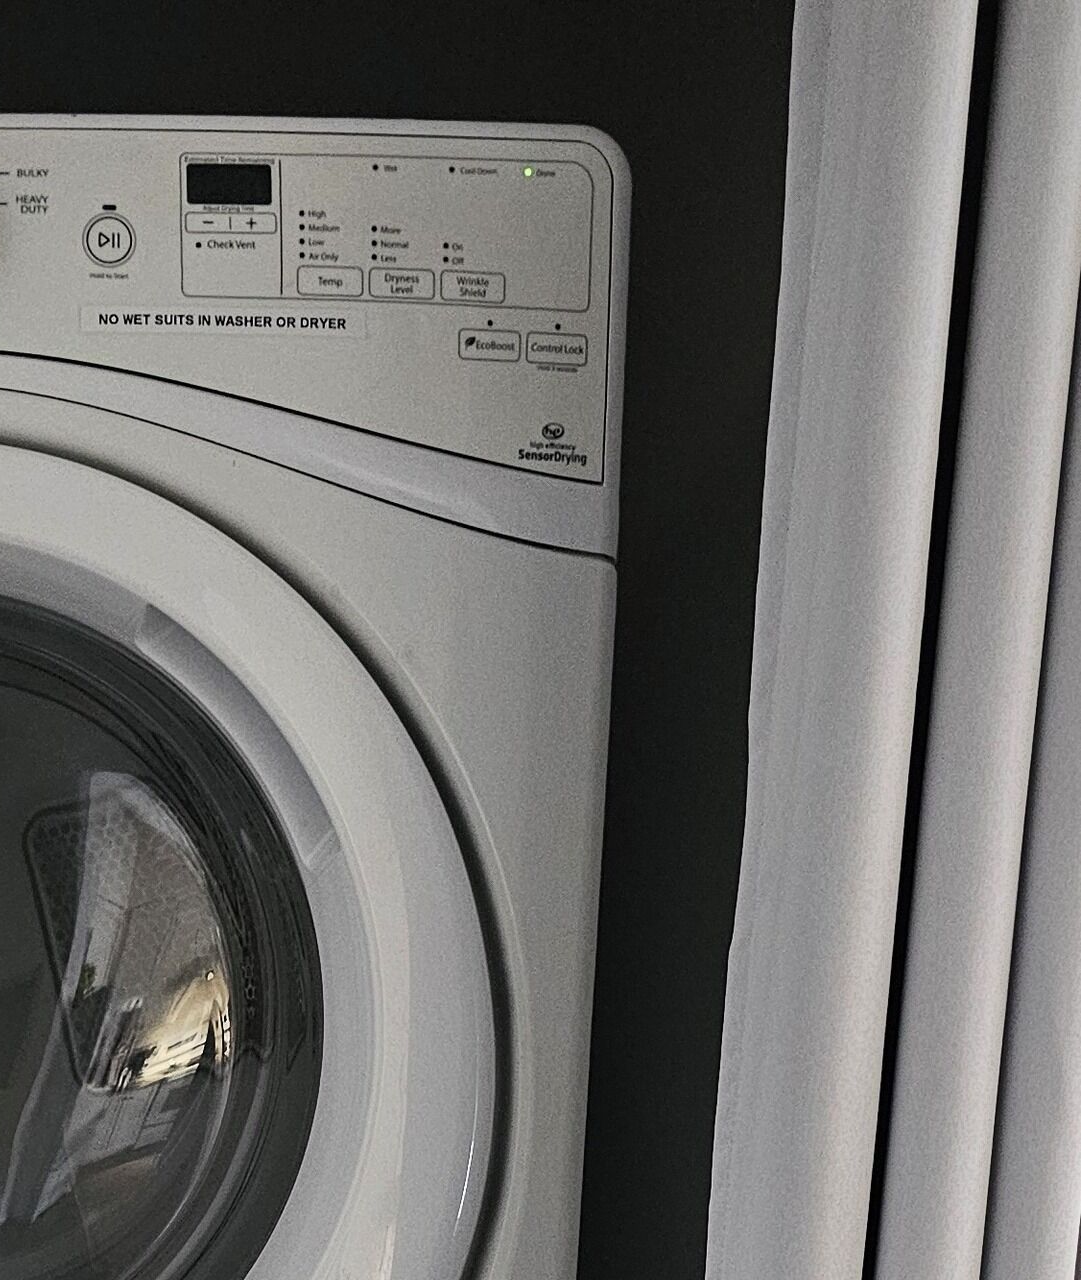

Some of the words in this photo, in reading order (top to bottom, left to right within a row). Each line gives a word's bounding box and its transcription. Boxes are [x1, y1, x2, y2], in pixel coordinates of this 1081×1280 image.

[16, 169, 50, 178] BULKY
[16, 196, 49, 205] HEAVY
[21, 205, 48, 214] DUTY
[308, 210, 327, 219] High
[308, 224, 341, 232] Medium
[380, 226, 401, 235] More
[207, 239, 234, 249] Check
[235, 240, 256, 249] Vent
[308, 238, 325, 246] Low
[380, 240, 409, 249] Normal
[308, 253, 320, 261] Air
[320, 253, 339, 262] Only
[380, 255, 397, 263] Less
[318, 276, 343, 288] Temp
[384, 274, 419, 285] Dryness
[456, 276, 490, 287] Wrinkle
[390, 285, 413, 294] Level
[459, 287, 487, 298] Shield
[98, 313, 119, 325] NO
[122, 313, 150, 325] WET
[155, 314, 194, 326] SUITS
[198, 315, 211, 326] IN
[214, 315, 272, 327] WASHER
[276, 316, 296, 328] OR
[300, 317, 346, 330] DRYER
[475, 340, 515, 351] EcoBoost
[530, 342, 563, 355] Control
[565, 343, 584, 355] Lock
[518, 449, 588, 466] SensorDrying
